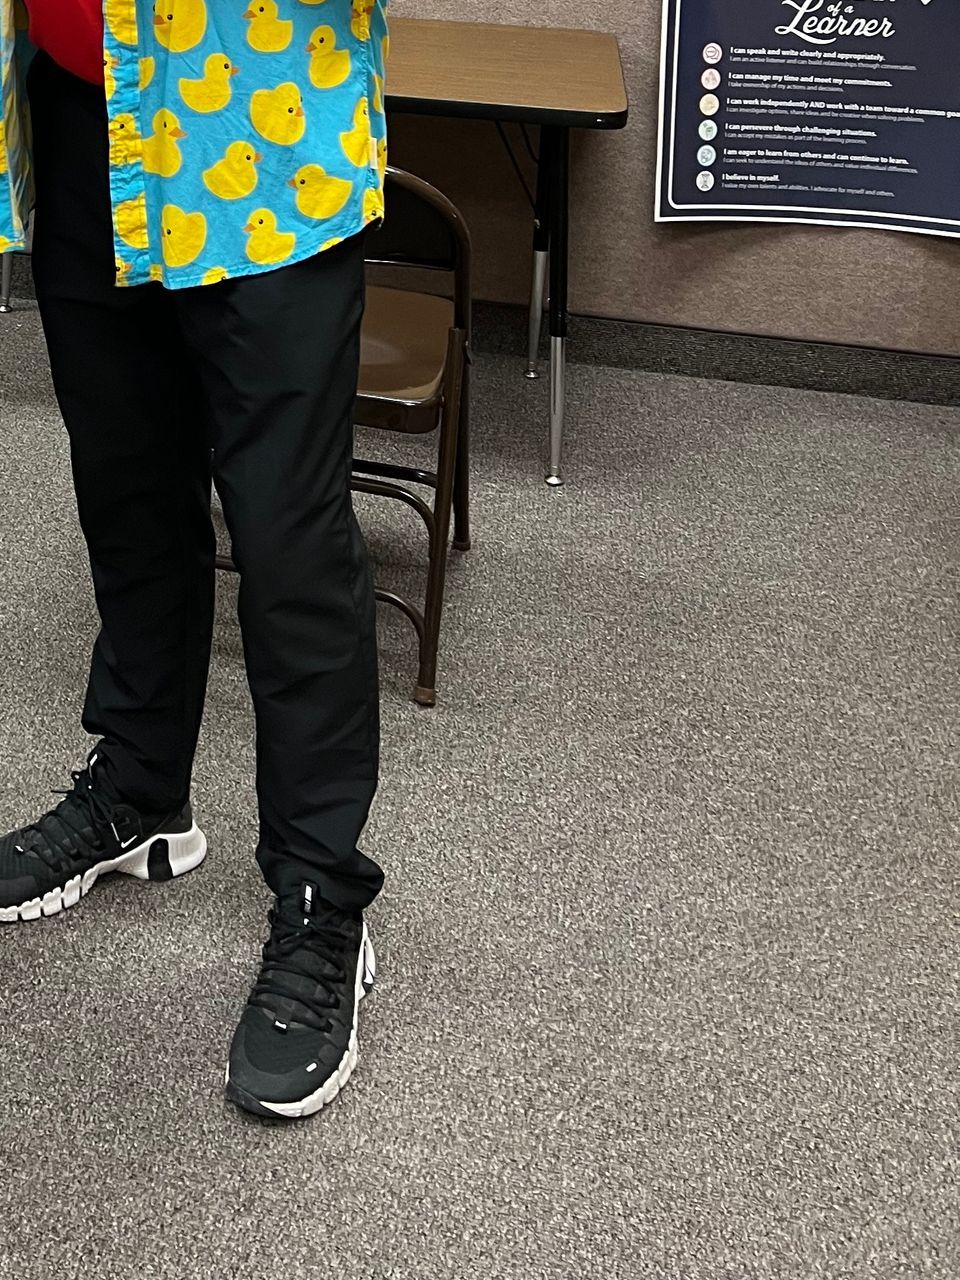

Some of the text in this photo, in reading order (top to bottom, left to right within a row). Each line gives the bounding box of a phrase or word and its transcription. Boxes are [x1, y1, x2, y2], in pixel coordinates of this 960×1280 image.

[827, 2, 854, 15] of a
[800, 50, 822, 58] clearly
[760, 99, 809, 108] independently
[774, 125, 800, 133] through
[850, 154, 879, 162] continue
